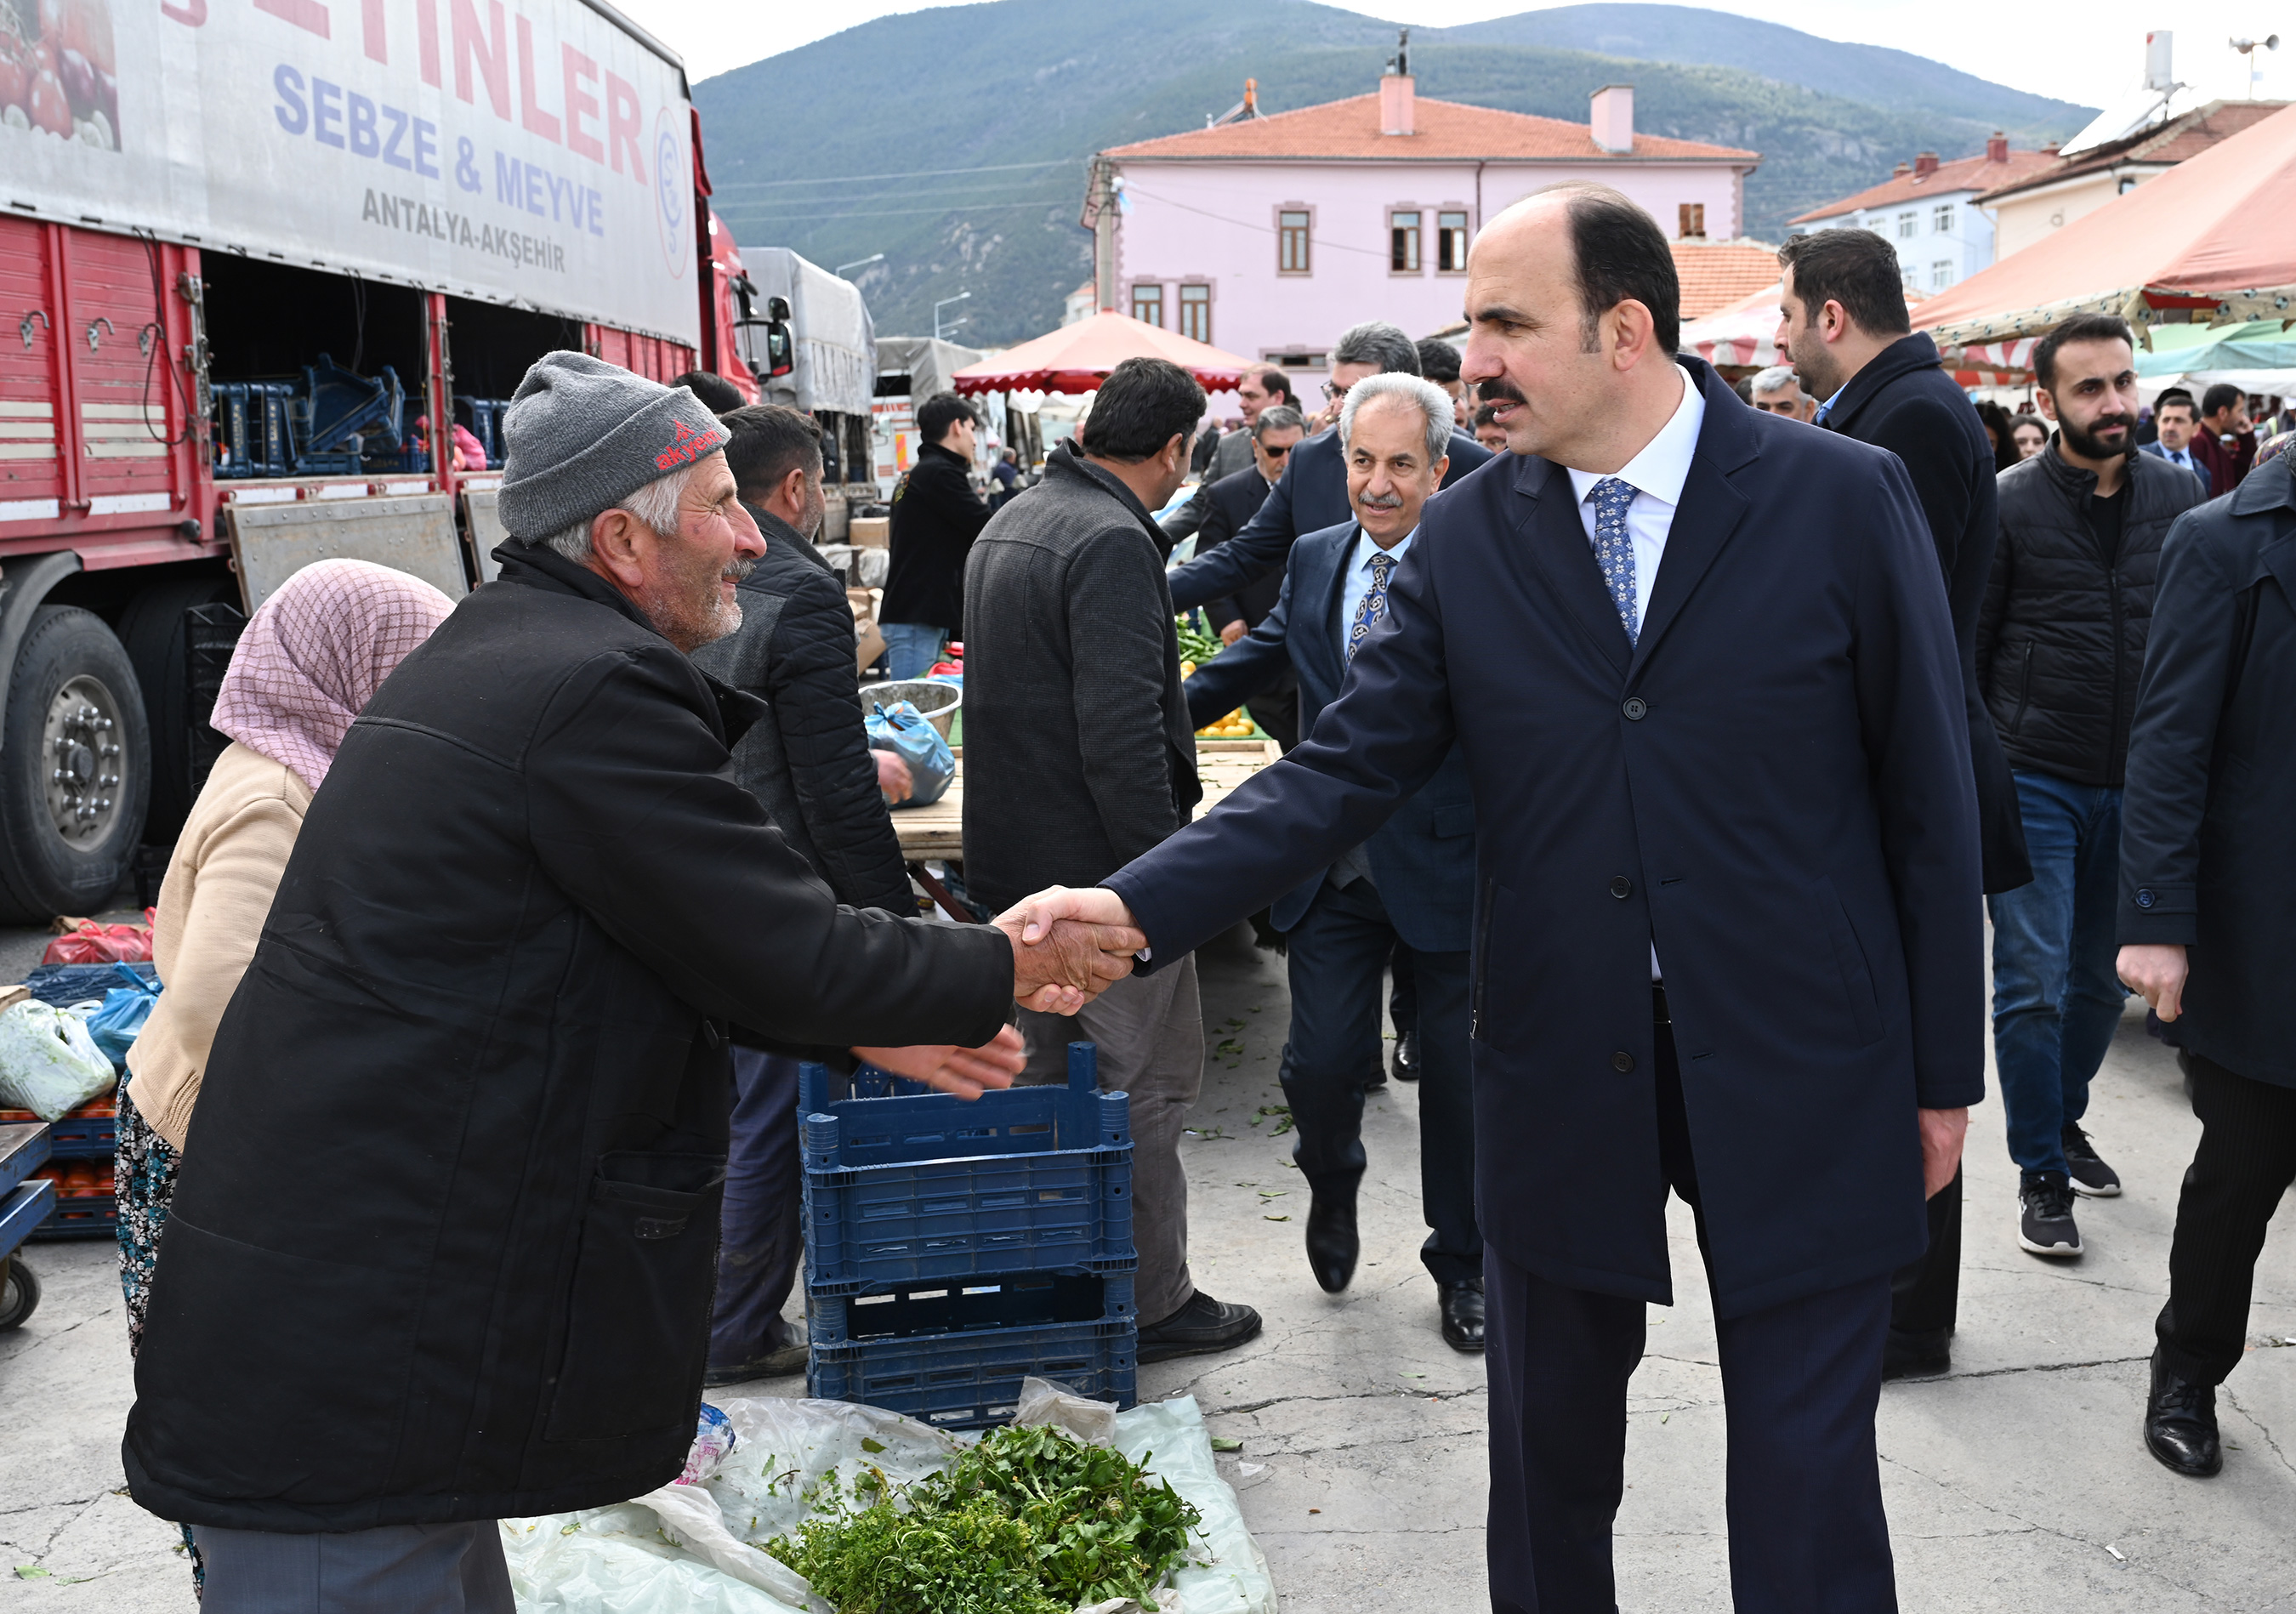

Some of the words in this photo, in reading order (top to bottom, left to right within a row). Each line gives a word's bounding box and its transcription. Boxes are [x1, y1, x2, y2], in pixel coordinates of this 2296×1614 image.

[273, 63, 440, 181] SEBZE
[455, 135, 482, 195] &
[494, 150, 604, 238] MEYVE
[362, 188, 565, 273] ANTALYA-AKŞEHİR
[656, 430, 722, 470] akyem
